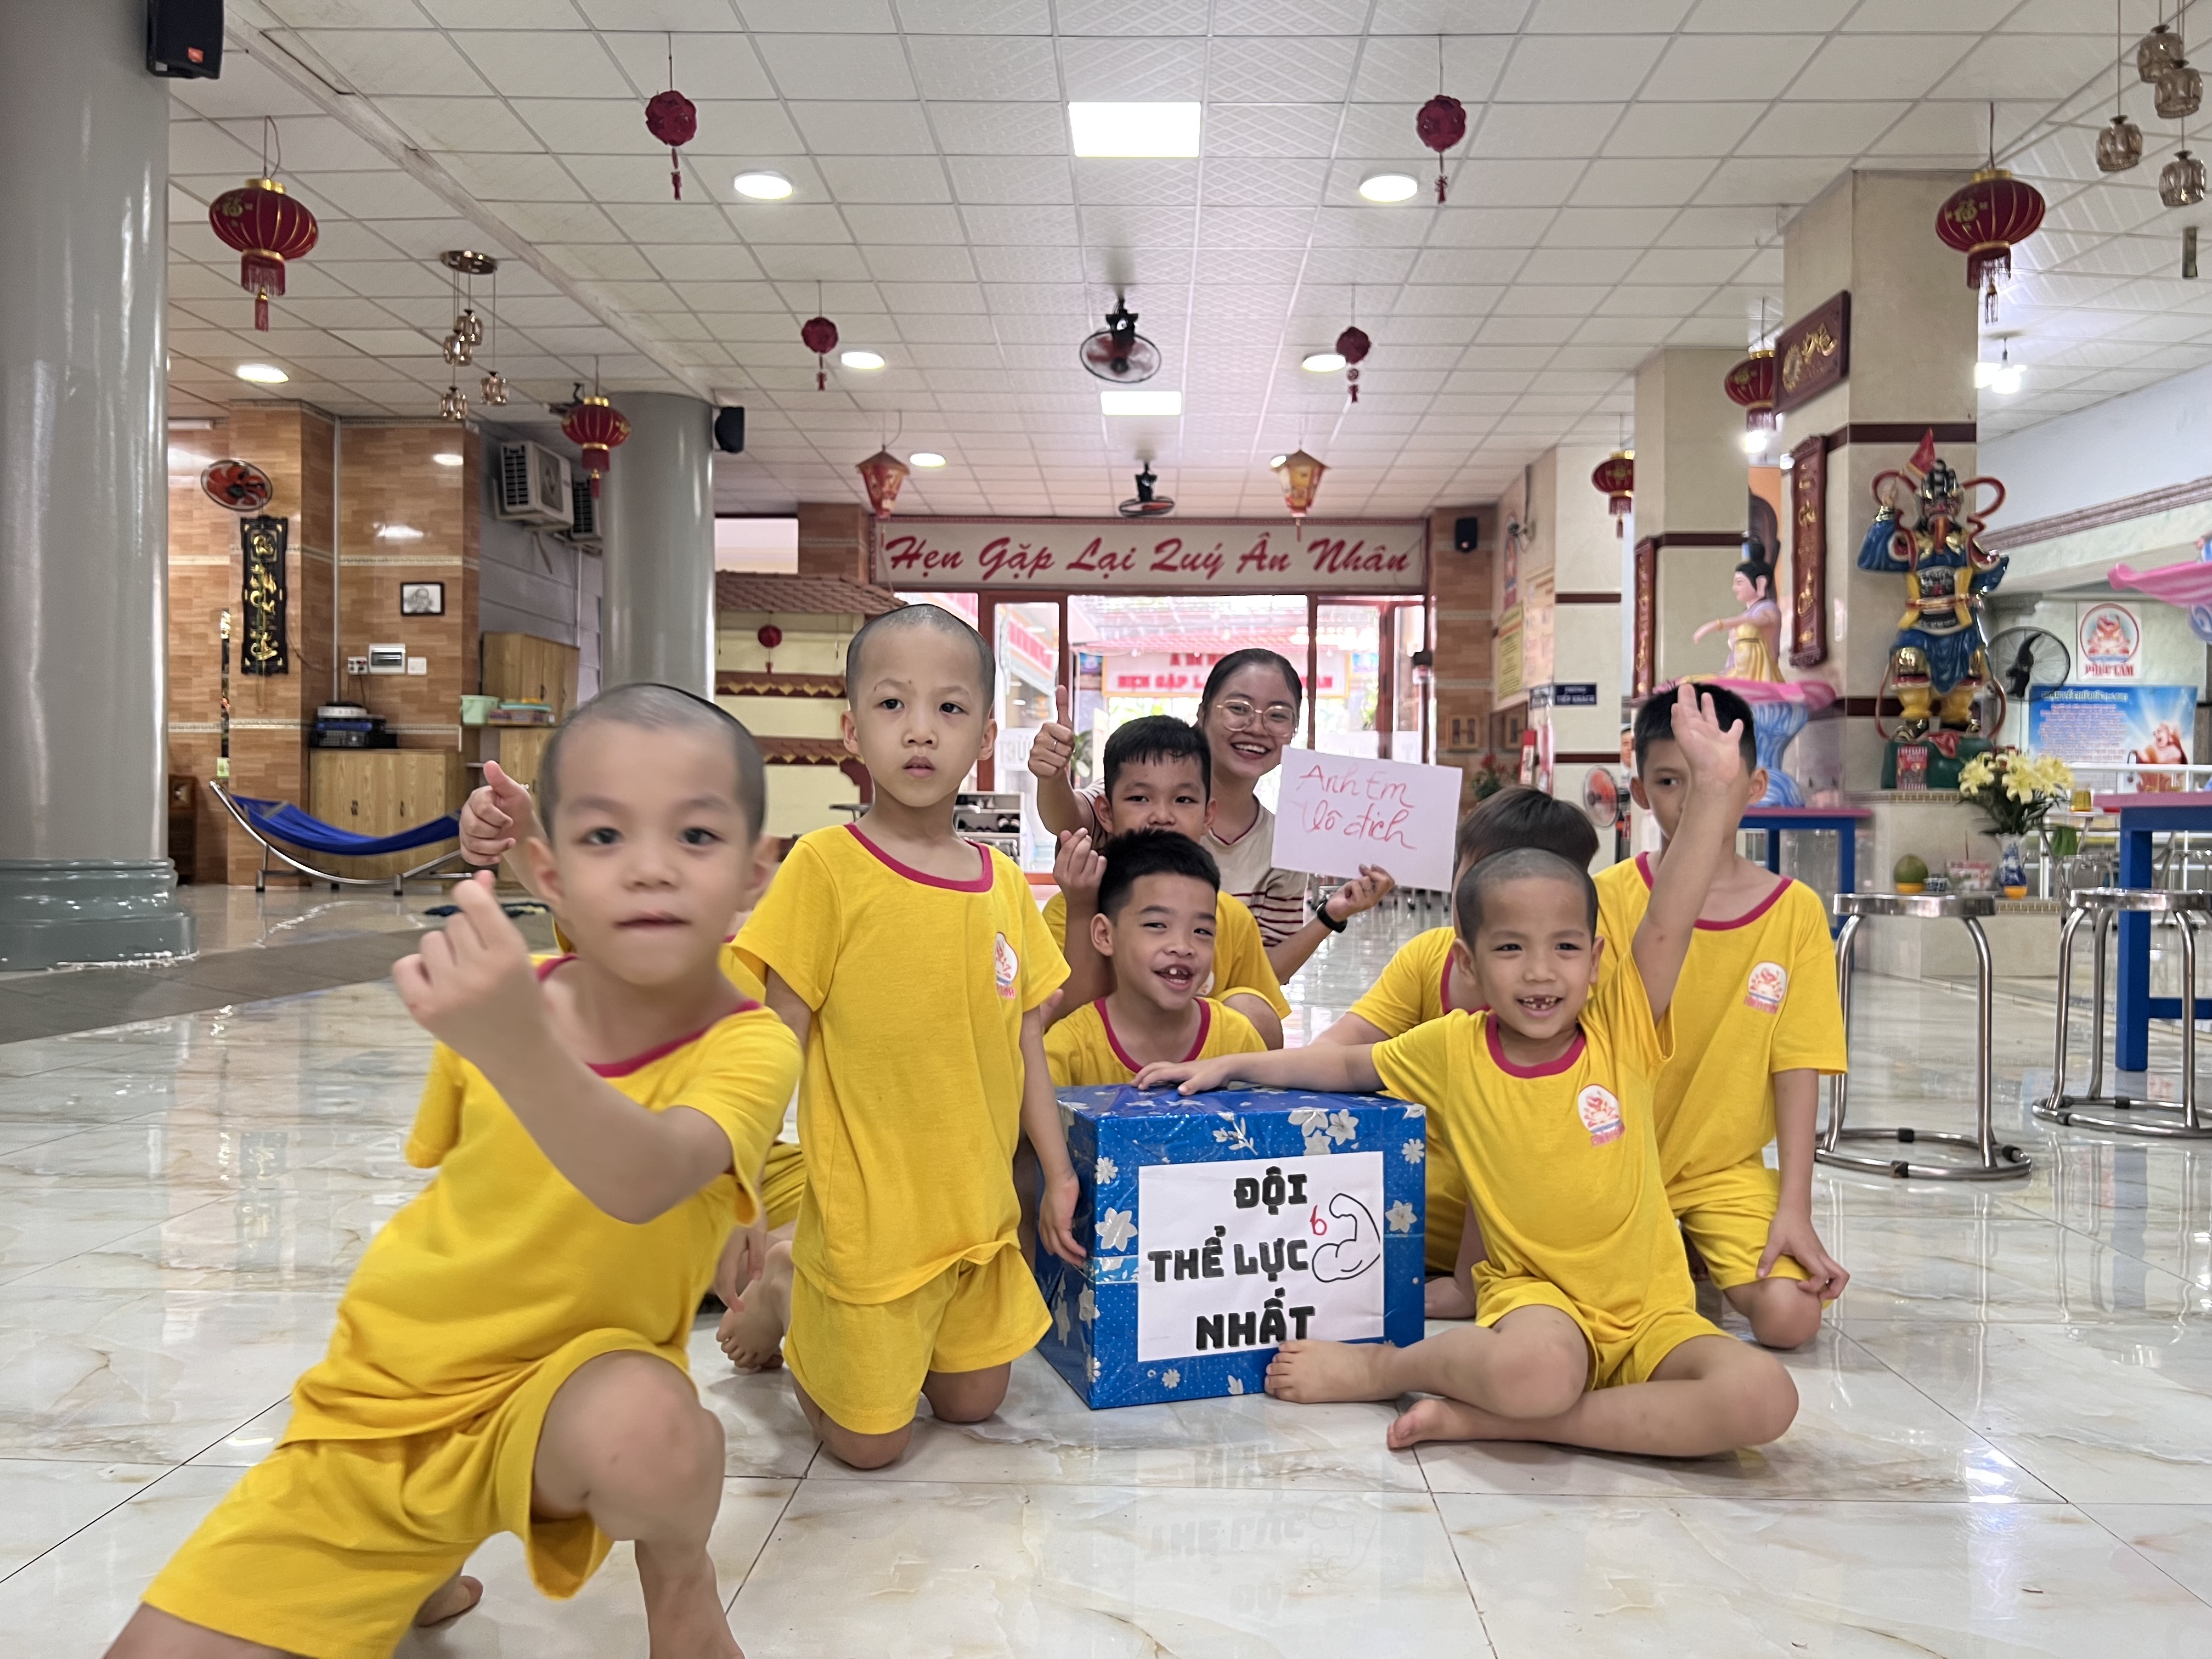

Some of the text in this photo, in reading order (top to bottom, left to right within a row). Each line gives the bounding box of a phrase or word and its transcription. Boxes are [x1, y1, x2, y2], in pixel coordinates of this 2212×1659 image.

[885, 532, 1410, 582] Hẹn Gặp Lại Quý Ân Nhân
[1296, 764, 1414, 808] Anh Em
[1234, 1166, 1308, 1215] ĐỘI
[1148, 1225, 1309, 1283] THỂ LỰC
[1196, 1287, 1315, 1350] NHẤT
